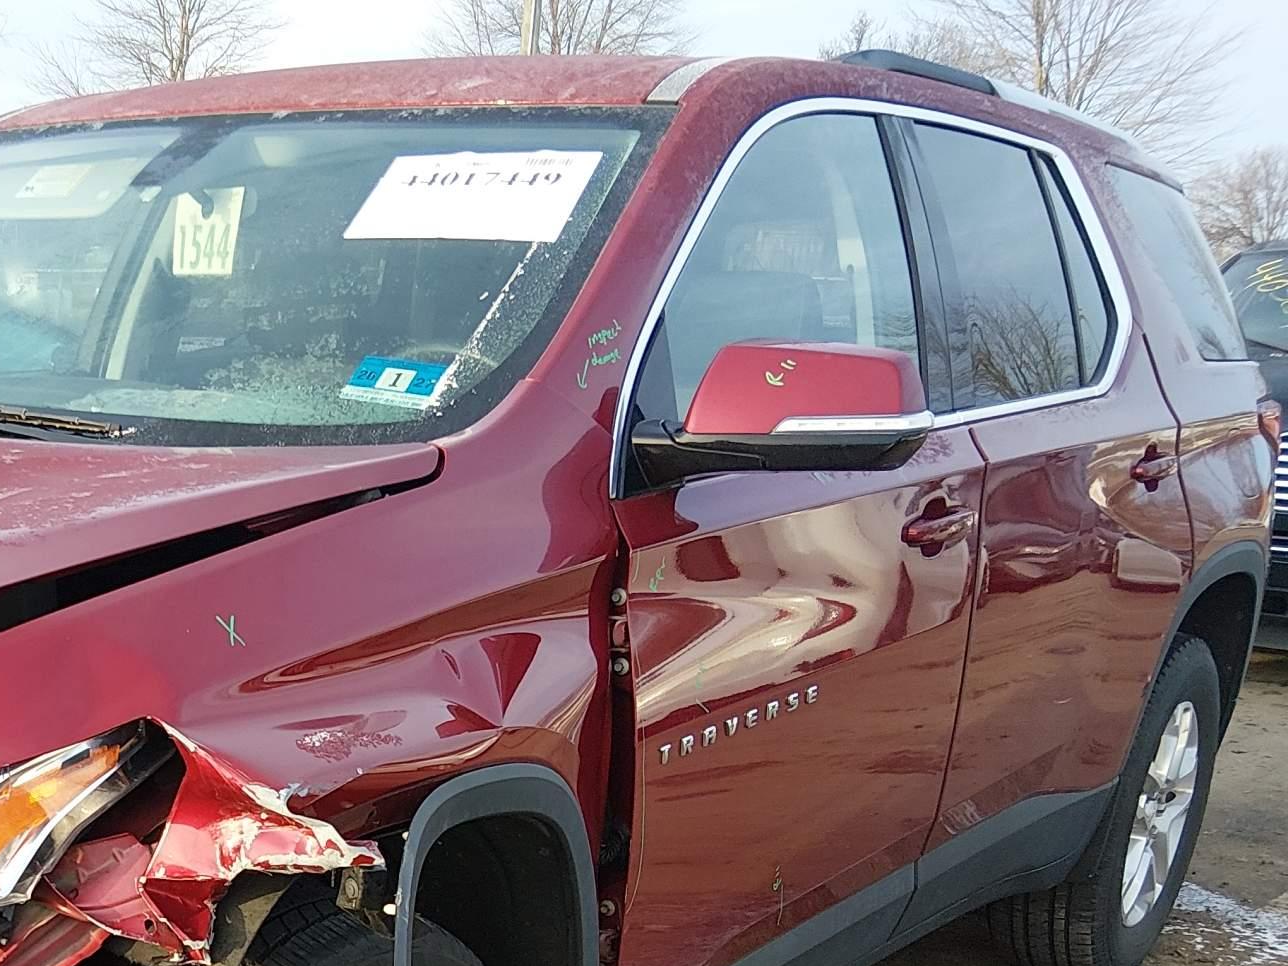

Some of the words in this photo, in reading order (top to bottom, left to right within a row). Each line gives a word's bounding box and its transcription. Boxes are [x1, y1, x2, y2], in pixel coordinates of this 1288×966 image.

[179, 224, 231, 271] 1544
[357, 369, 376, 381] 20
[388, 372, 403, 388] 1
[659, 685, 820, 766] TRAVERSE
